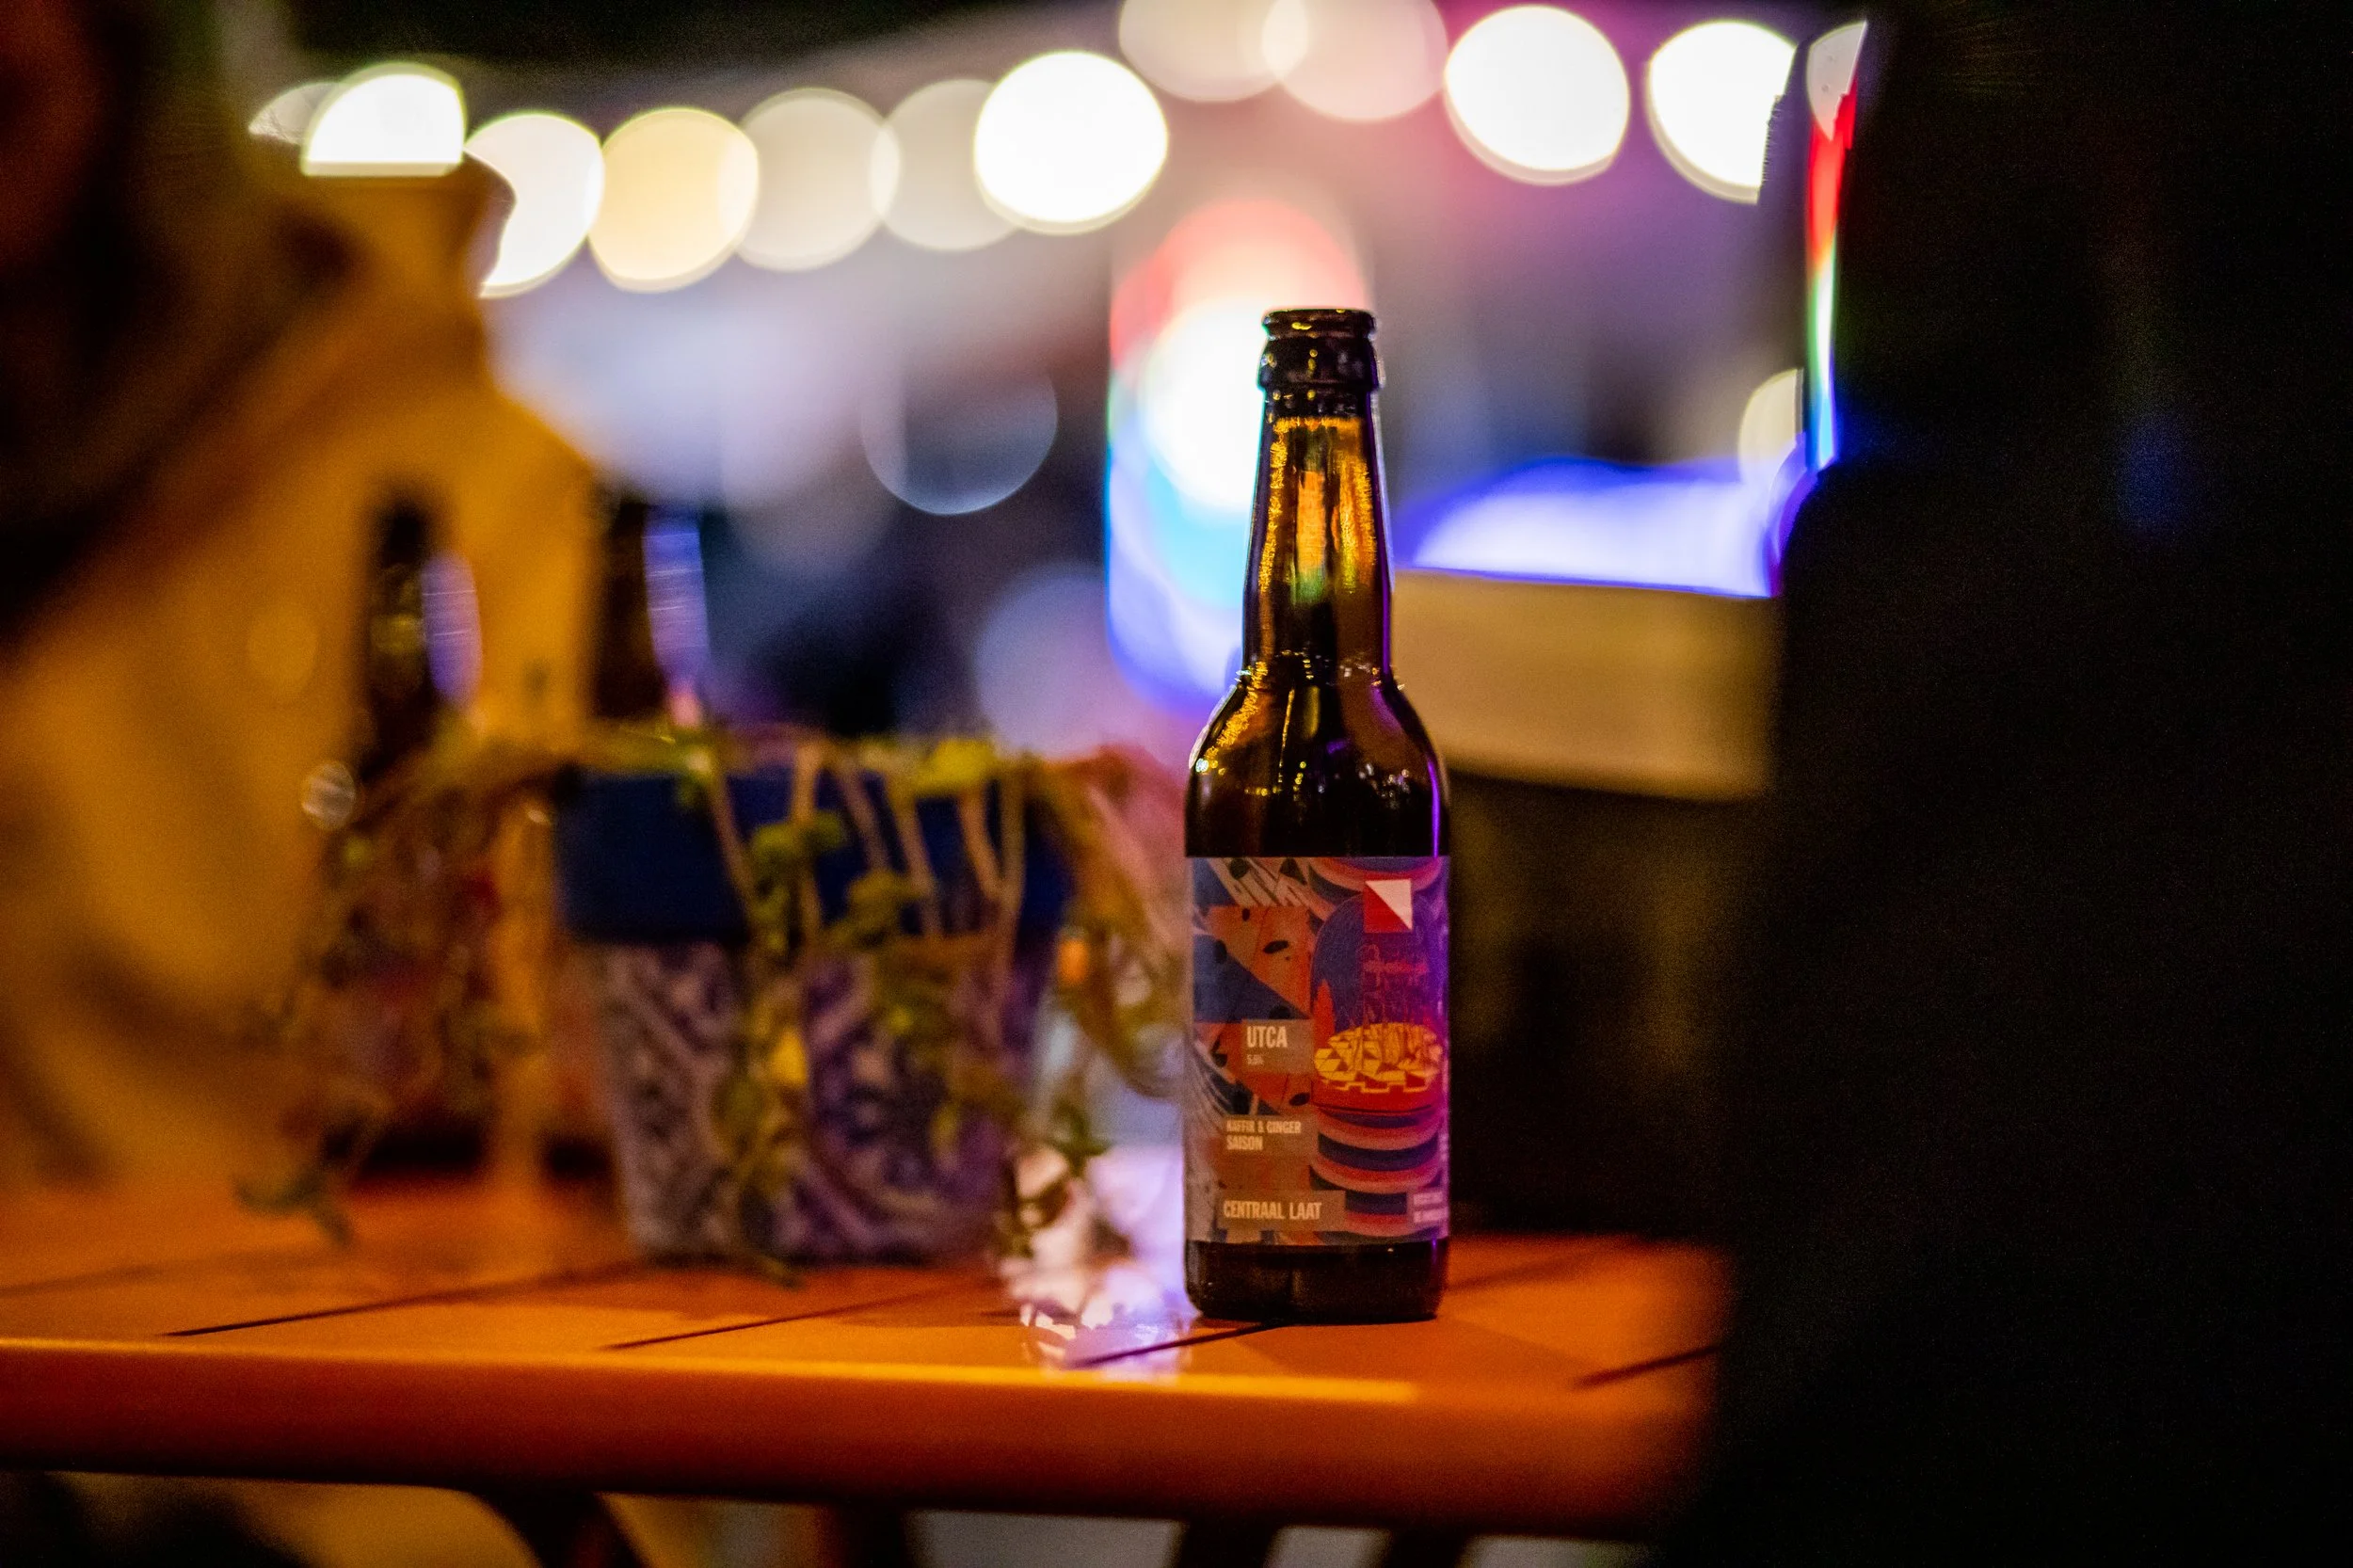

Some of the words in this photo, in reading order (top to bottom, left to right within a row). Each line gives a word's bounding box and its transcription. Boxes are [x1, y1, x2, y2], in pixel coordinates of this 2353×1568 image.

[1246, 1025, 1289, 1048] UTCA
[1266, 1120, 1301, 1133] GINGER
[1226, 1135, 1263, 1150] SAISON
[1224, 1200, 1286, 1219] CENTRAAL
[1289, 1202, 1322, 1221] LAAT
